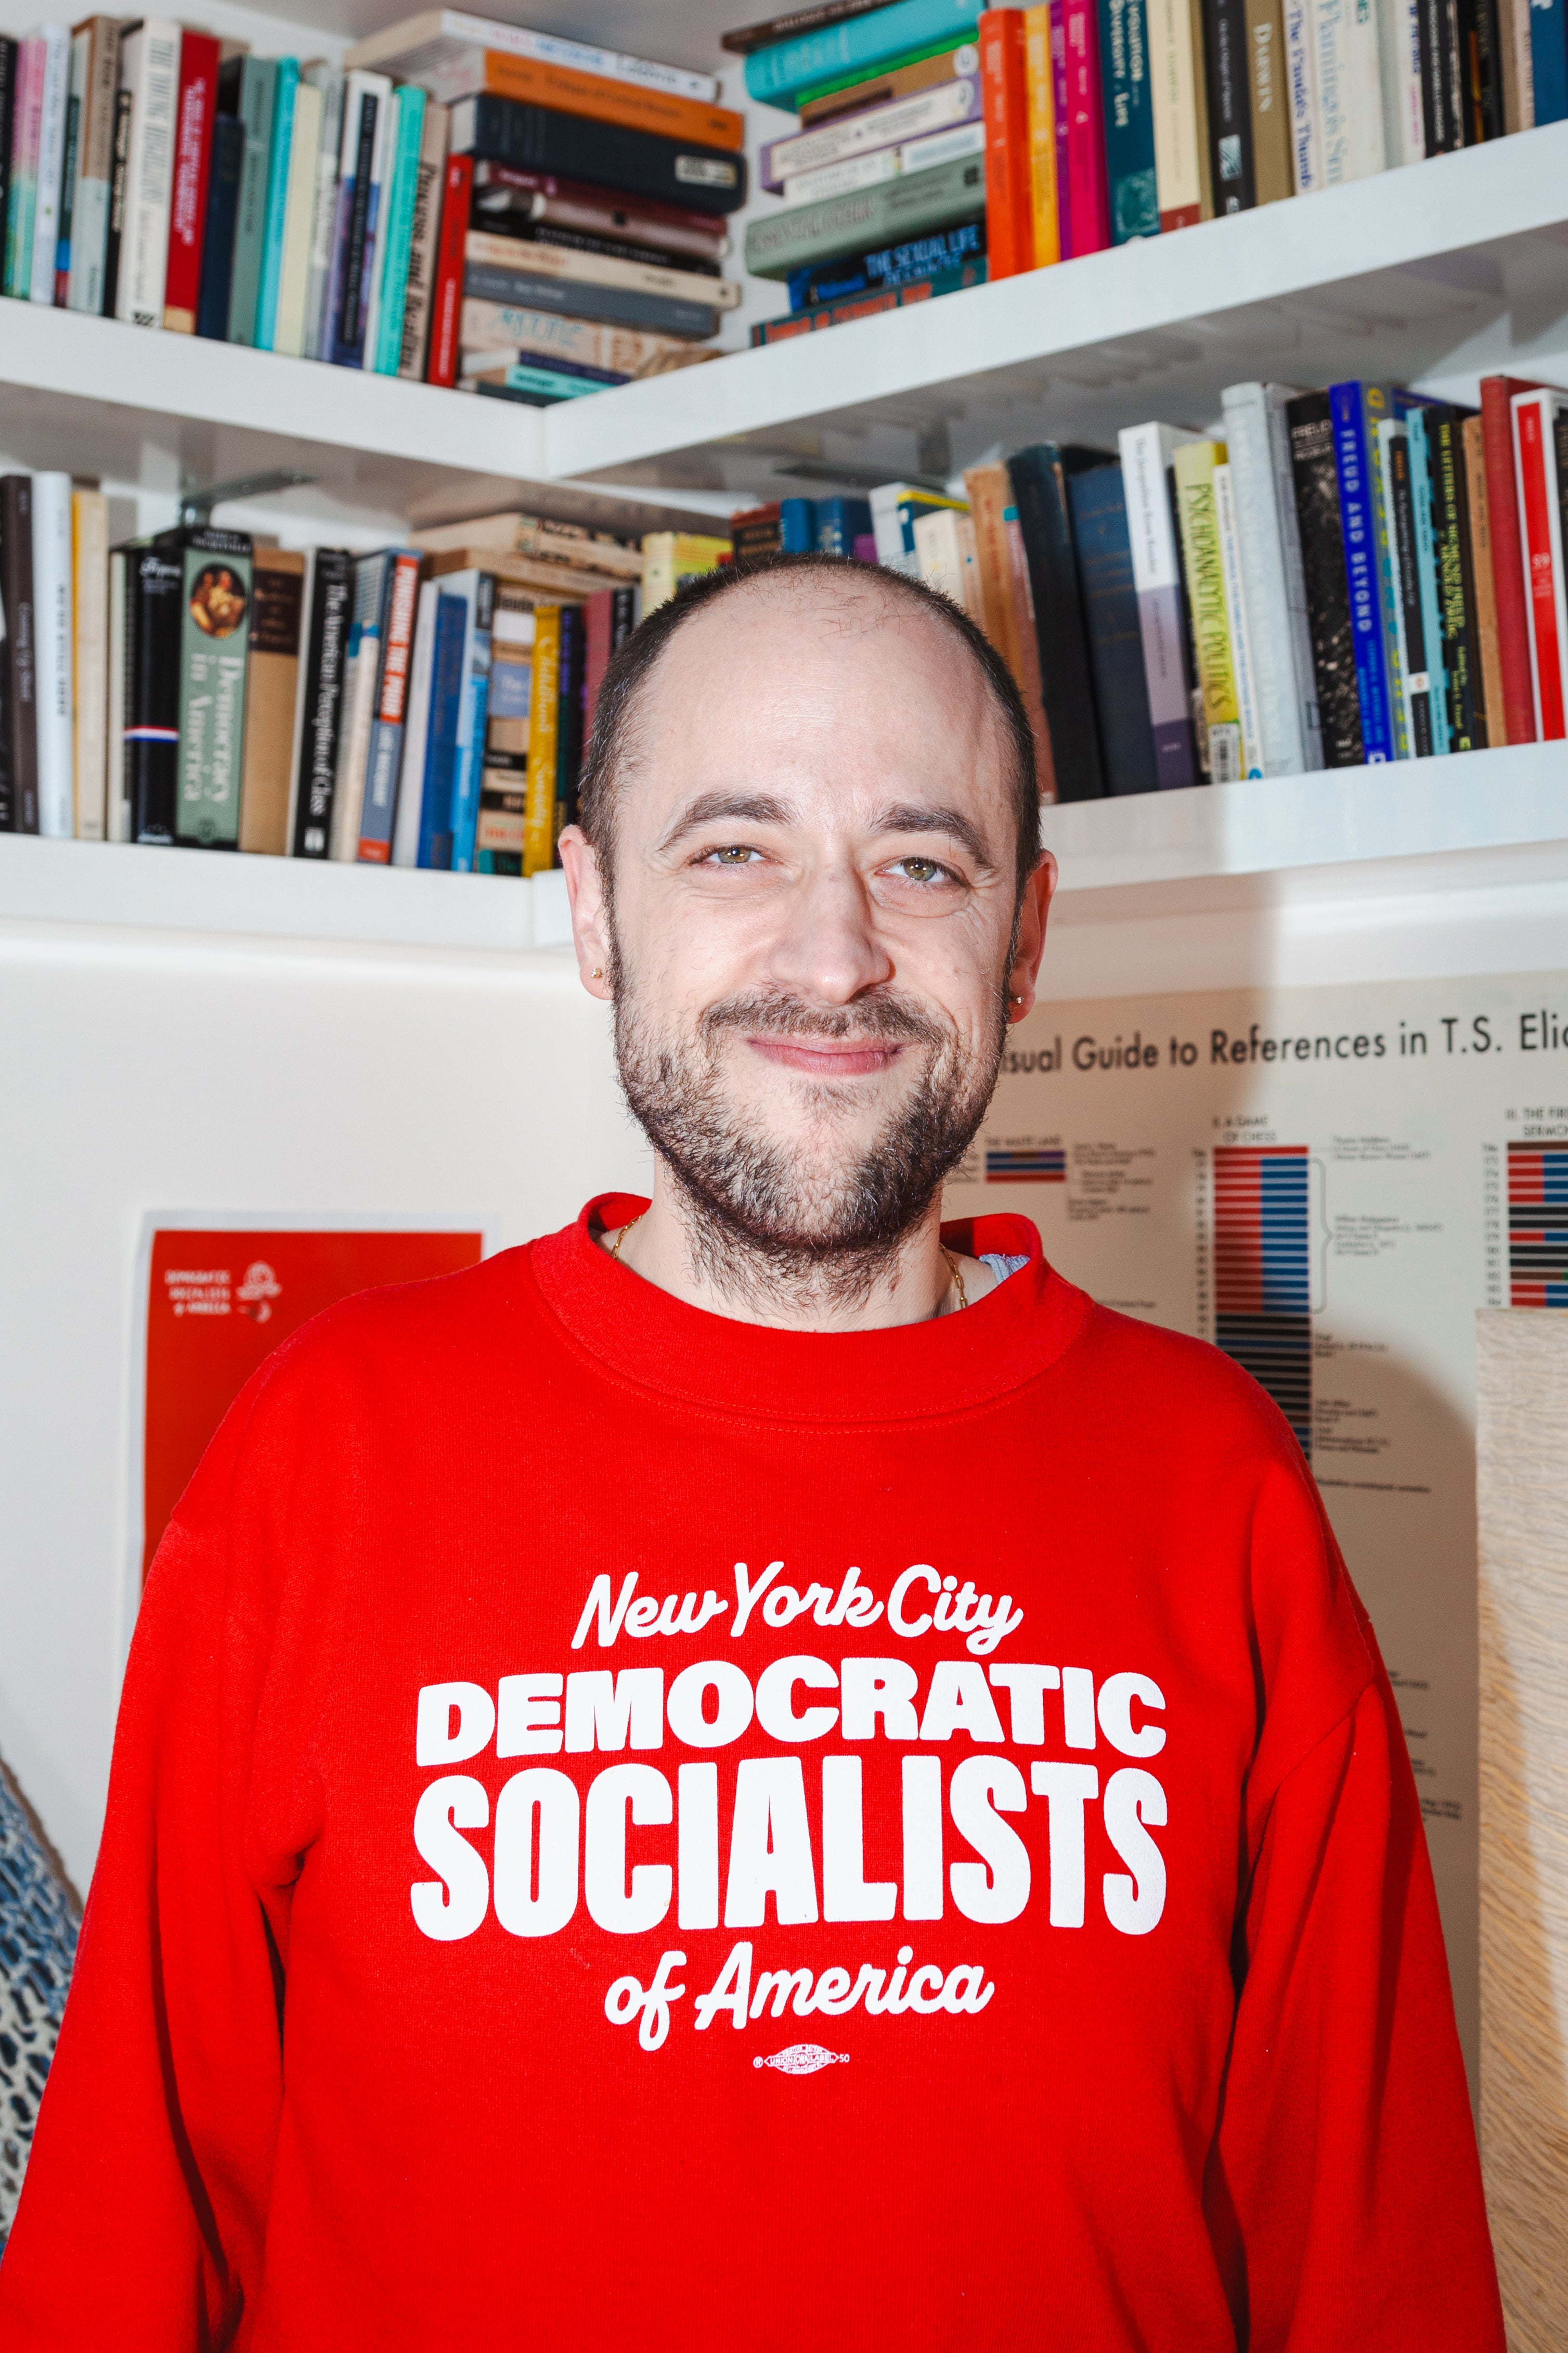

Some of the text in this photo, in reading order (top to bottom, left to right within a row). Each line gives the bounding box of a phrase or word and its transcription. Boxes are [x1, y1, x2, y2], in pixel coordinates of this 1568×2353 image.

[1287, 9, 1301, 42] The
[1296, 125, 1314, 187] Thumb
[864, 249, 892, 278] THE
[892, 233, 946, 268] SEXUAL
[948, 224, 981, 252] LIFE
[1186, 482, 1232, 710] PSYCHOANALYTIC POLITICS
[1340, 429, 1373, 633] FREUD AND BEYOND
[1439, 424, 1465, 628] THE LETTERS OF SIGMUND FREUD
[310, 584, 349, 817] The American Perception of Class
[381, 566, 417, 716] PUNISHING THE POOR
[184, 653, 215, 802] in America
[213, 655, 242, 803] Democracy
[1072, 1030, 1159, 1070] Guide
[1169, 1035, 1198, 1067] to
[1210, 1023, 1386, 1064] References
[1399, 1020, 1427, 1055] in
[1441, 1015, 1502, 1053] T.S.
[571, 1561, 1023, 1654] New York City
[416, 1655, 1167, 1767] DEMOCRATIC
[411, 1755, 1168, 1941] SOCIALISTS
[604, 1941, 994, 2051] of America
[770, 2057, 795, 2065] UNION
[810, 2054, 834, 2062] LABEL
[839, 2053, 850, 2063] 50
